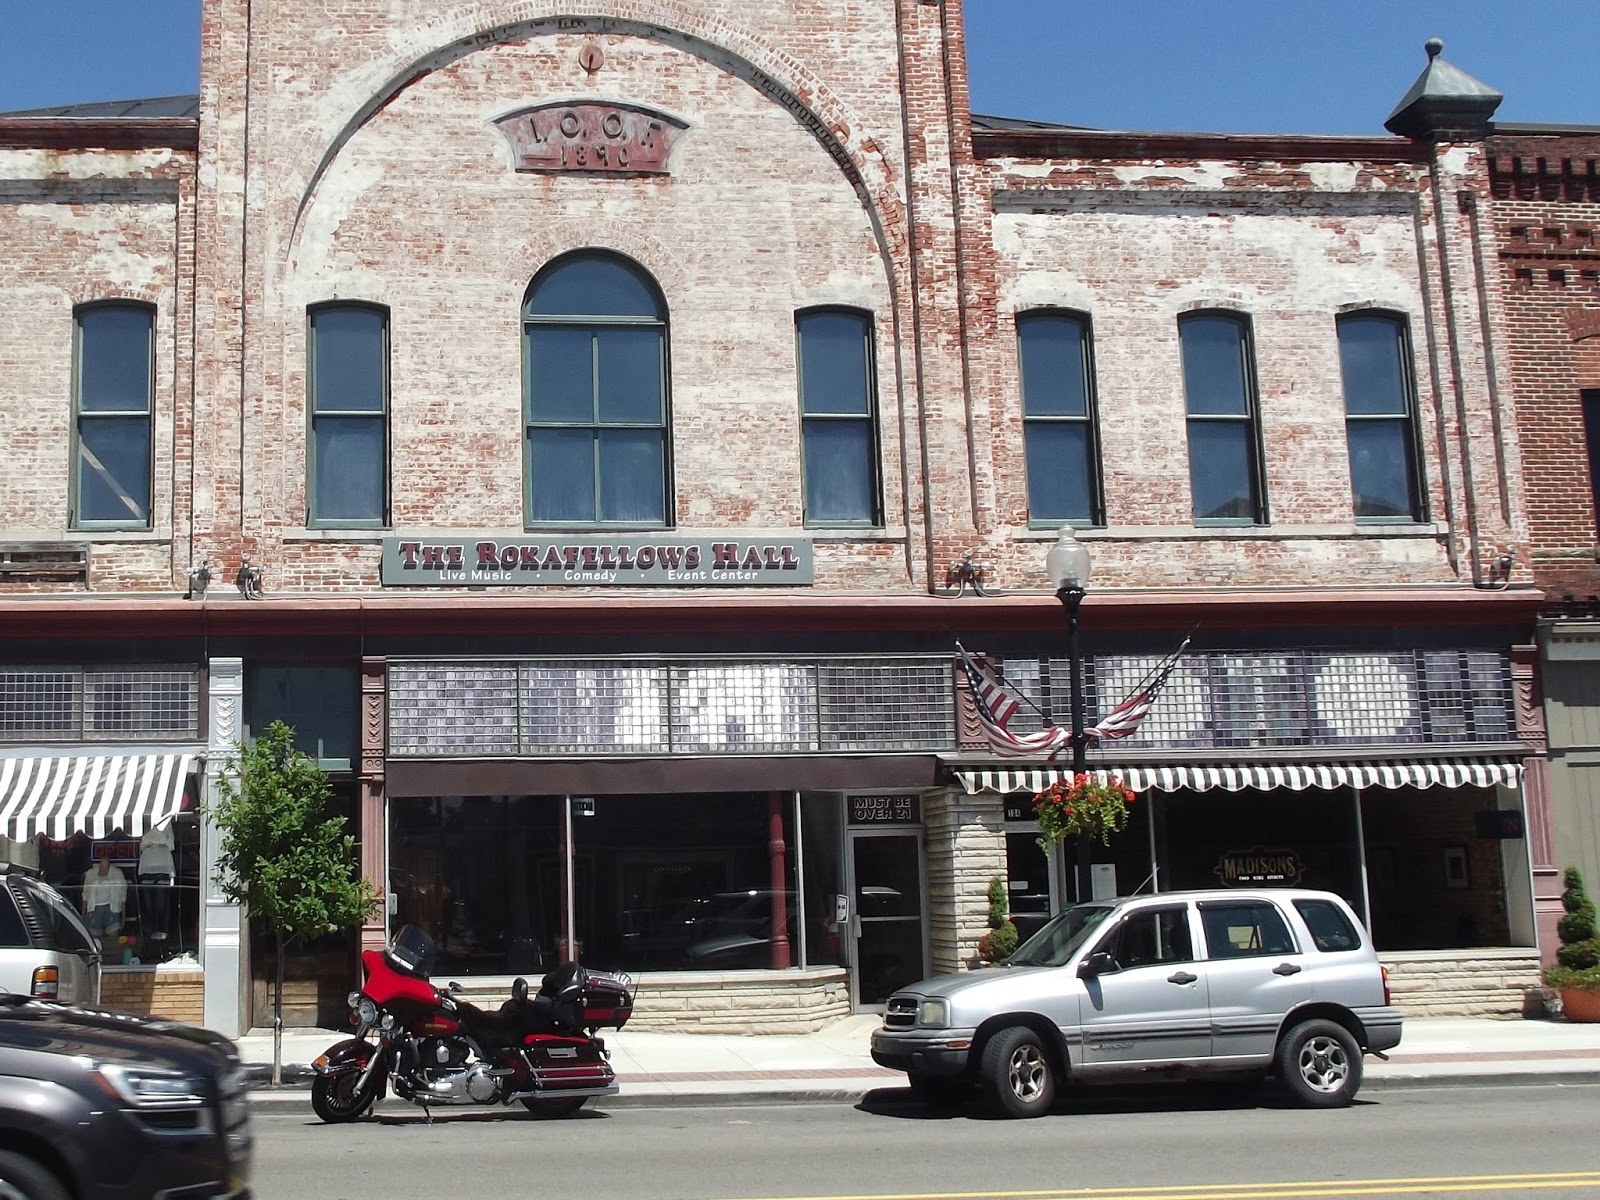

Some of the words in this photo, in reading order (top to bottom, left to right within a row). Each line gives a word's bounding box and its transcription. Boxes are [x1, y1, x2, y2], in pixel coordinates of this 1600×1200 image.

[561, 146, 629, 168] 1890
[398, 541, 464, 570] THE
[475, 541, 701, 571] ROKAFELLOWS
[711, 542, 800, 570] HALL
[439, 569, 466, 581] Live
[471, 569, 512, 581] Music
[564, 569, 617, 582] Comedy
[668, 569, 707, 581] Event
[711, 569, 758, 581] Center
[854, 797, 891, 809] MUST
[894, 797, 911, 808] BE
[855, 808, 892, 820] OVER
[896, 808, 911, 819] 21
[1223, 856, 1296, 878] MADISONS
